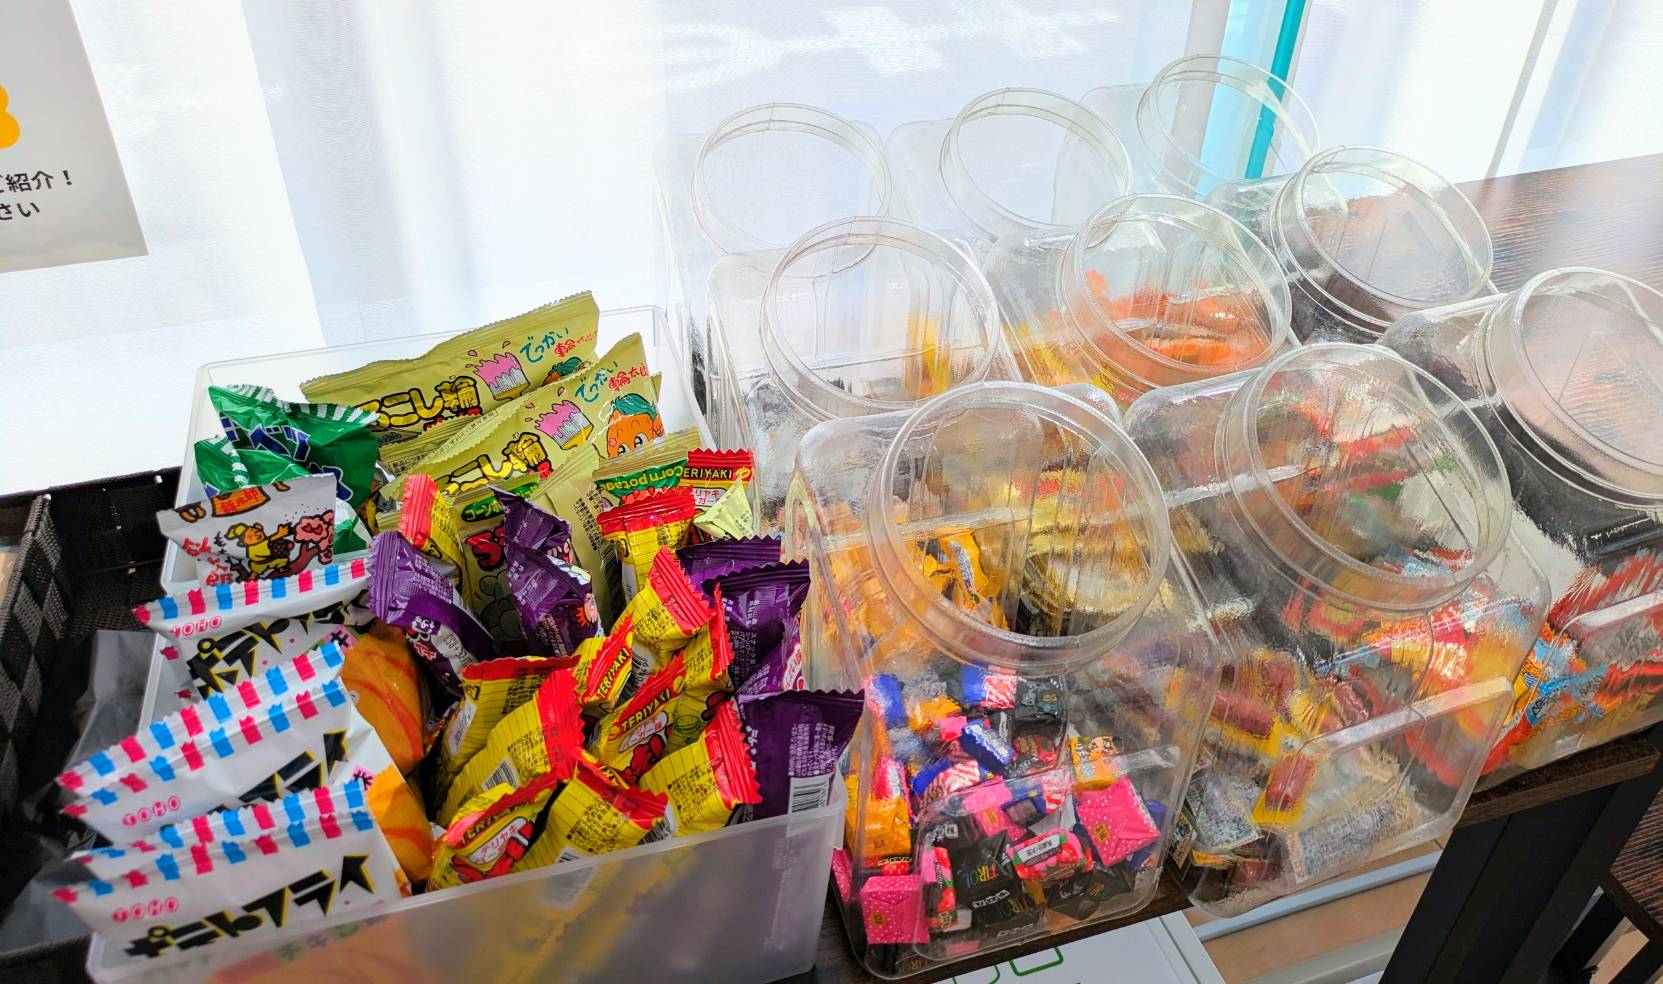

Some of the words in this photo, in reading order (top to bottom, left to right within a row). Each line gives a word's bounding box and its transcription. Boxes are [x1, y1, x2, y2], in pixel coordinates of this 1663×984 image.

[520, 327, 569, 363] でっかい
[575, 361, 618, 403] でっかい
[649, 464, 684, 482] Corn
[683, 467, 733, 479] ERIYAKI
[694, 489, 719, 498] リヤキ
[170, 615, 222, 638] TOHO
[597, 647, 632, 699] TERIYAKI
[621, 688, 671, 733] TERIYAKI
[121, 796, 181, 827] TOHO
[112, 897, 181, 922] TOHO
